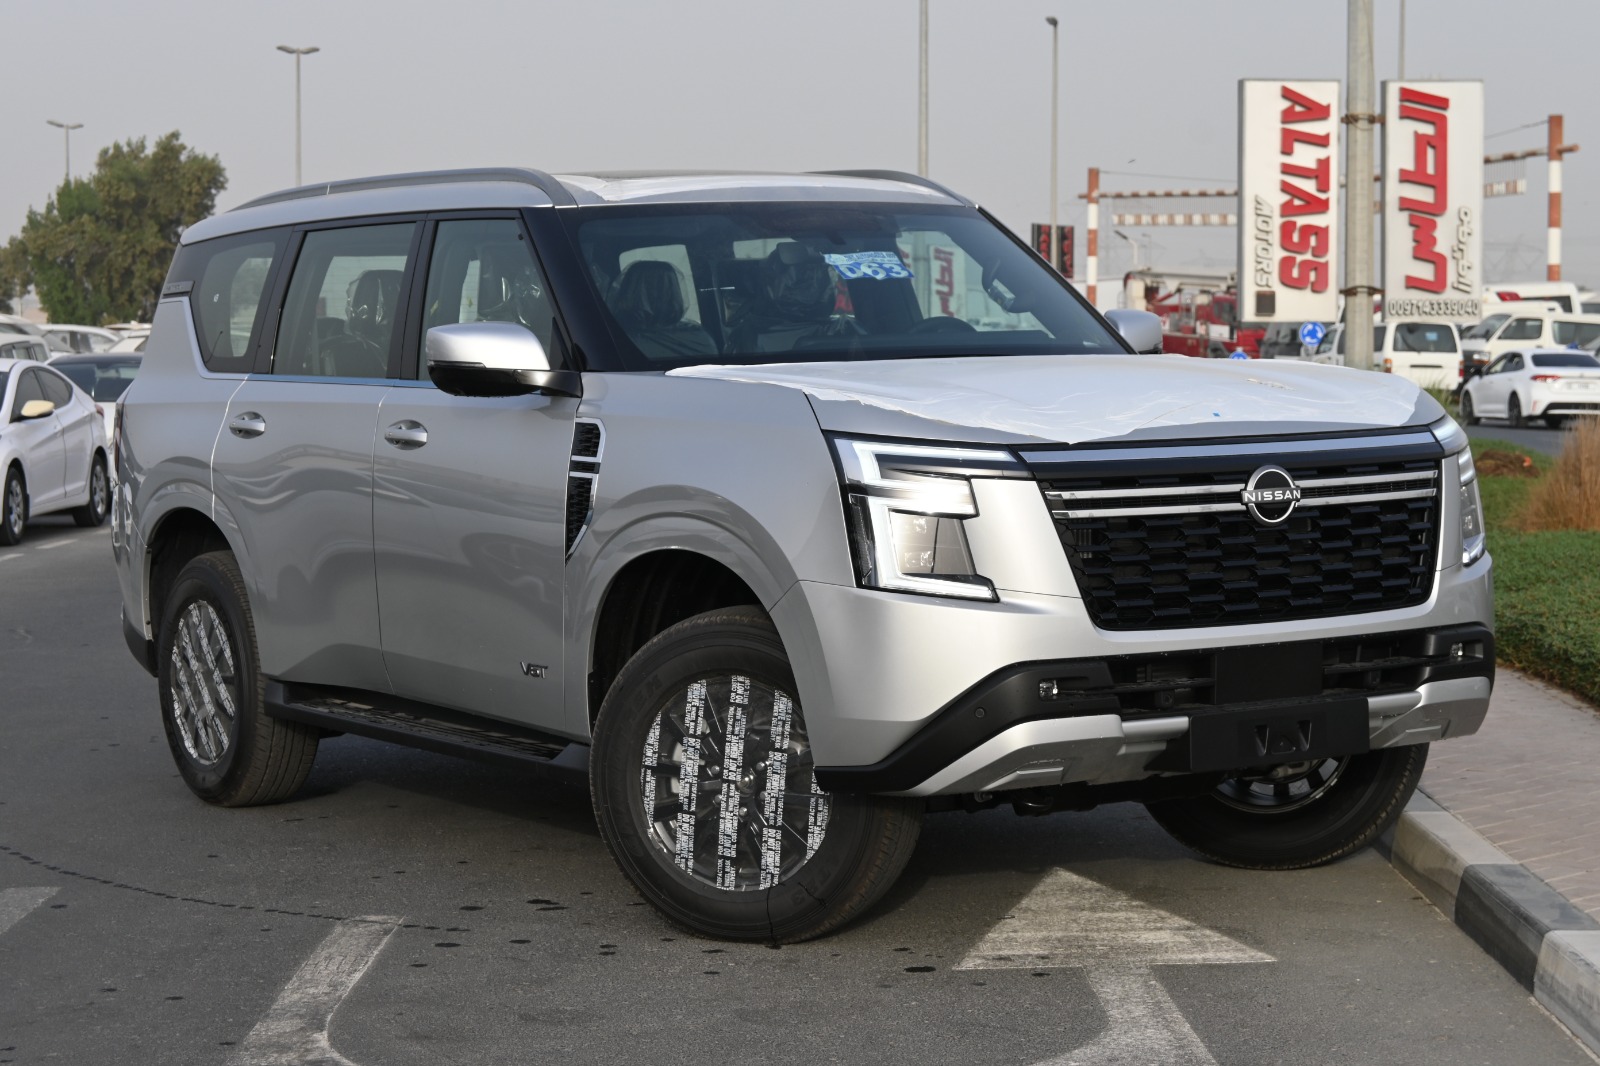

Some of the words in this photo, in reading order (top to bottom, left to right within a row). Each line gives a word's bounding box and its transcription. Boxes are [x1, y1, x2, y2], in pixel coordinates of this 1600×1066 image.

[1255, 195, 1274, 288] MOTORS
[1280, 85, 1330, 293] ALTASS
[1399, 86, 1450, 294] الطاس
[1244, 489, 1300, 502] NISSAN
